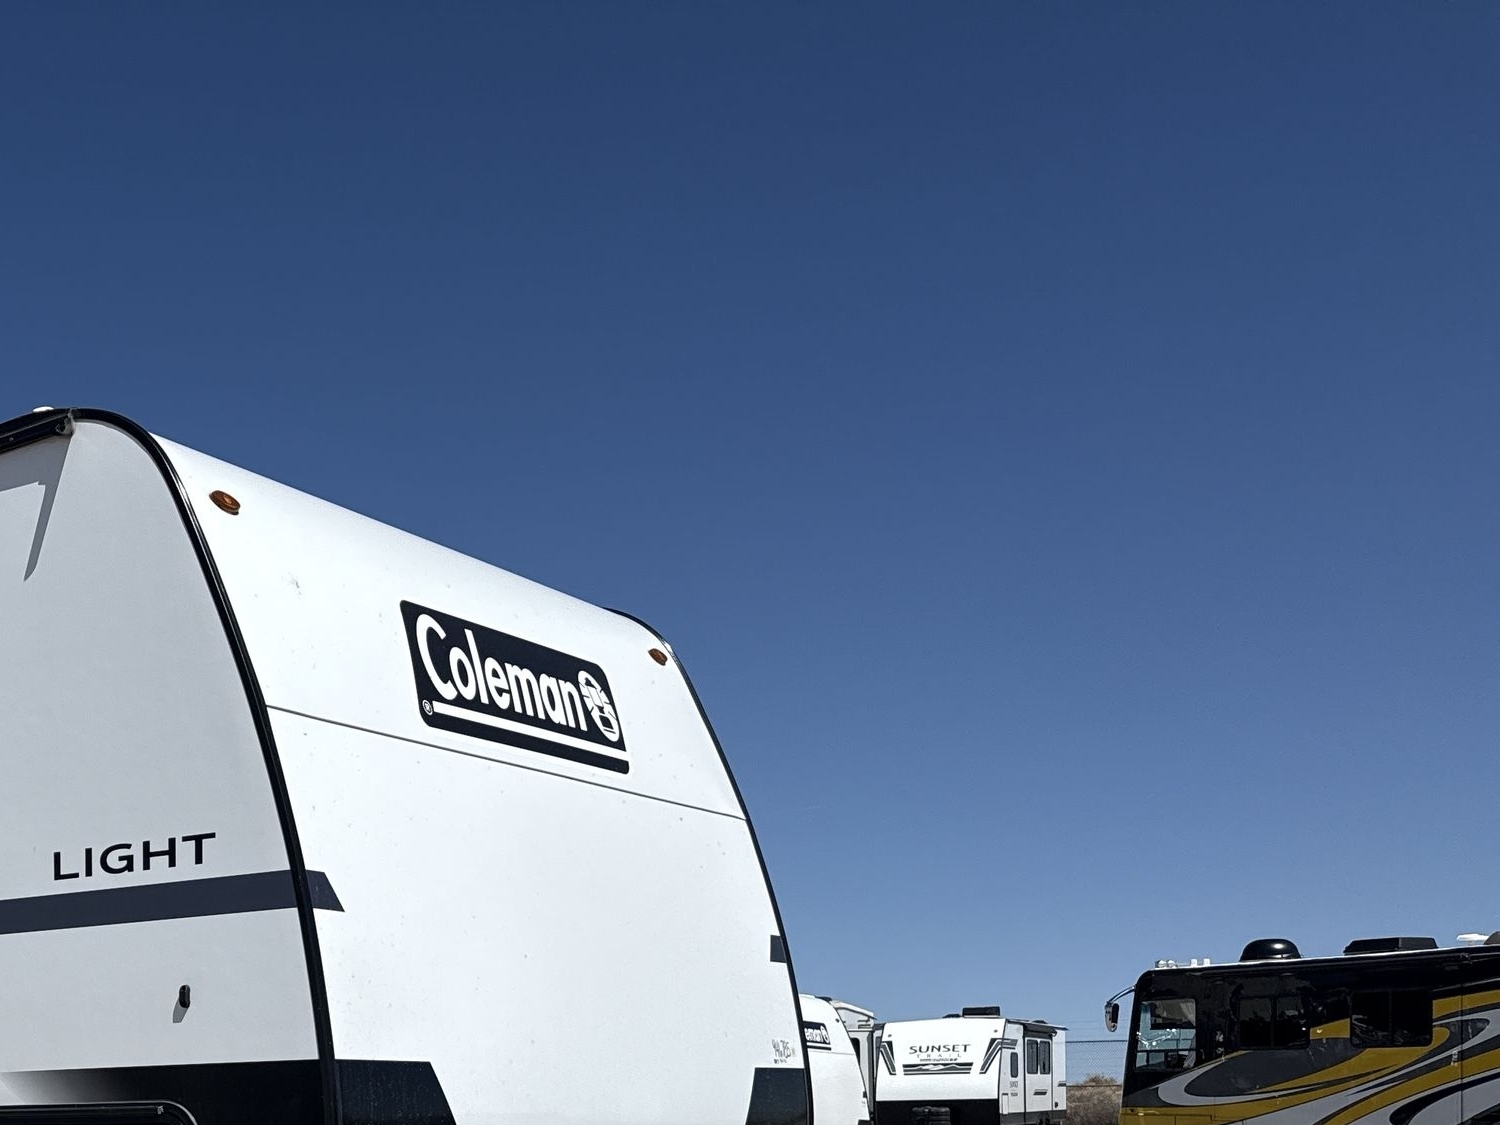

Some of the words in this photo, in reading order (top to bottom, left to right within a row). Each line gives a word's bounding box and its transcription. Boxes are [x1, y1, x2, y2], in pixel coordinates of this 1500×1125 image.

[415, 613, 588, 732] Coleman
[53, 832, 217, 881] LIGHT
[804, 1027, 824, 1043] eman
[909, 1043, 971, 1055] SUNSET
